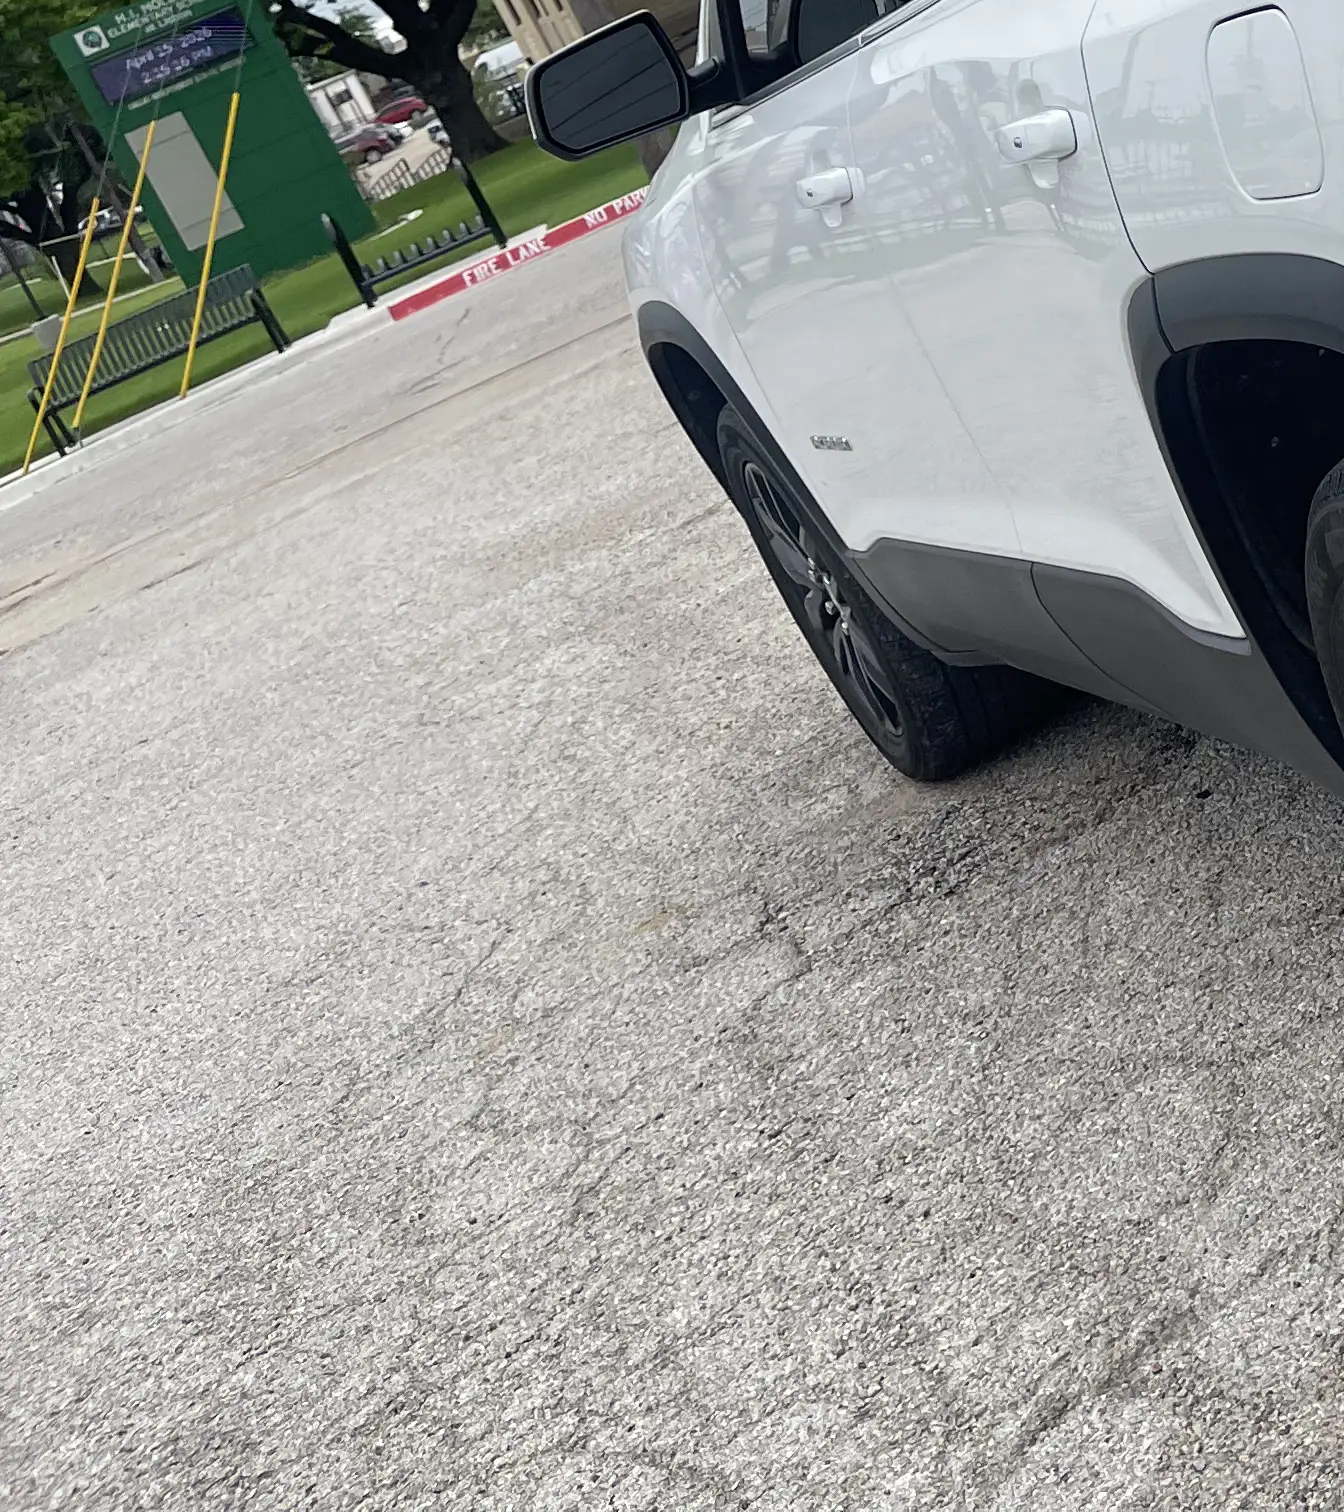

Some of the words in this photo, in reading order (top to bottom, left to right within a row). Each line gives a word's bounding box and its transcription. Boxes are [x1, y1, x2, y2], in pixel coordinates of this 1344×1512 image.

[462, 257, 502, 287] FIRE
[505, 237, 551, 266] LANE
[582, 207, 608, 229] NO
